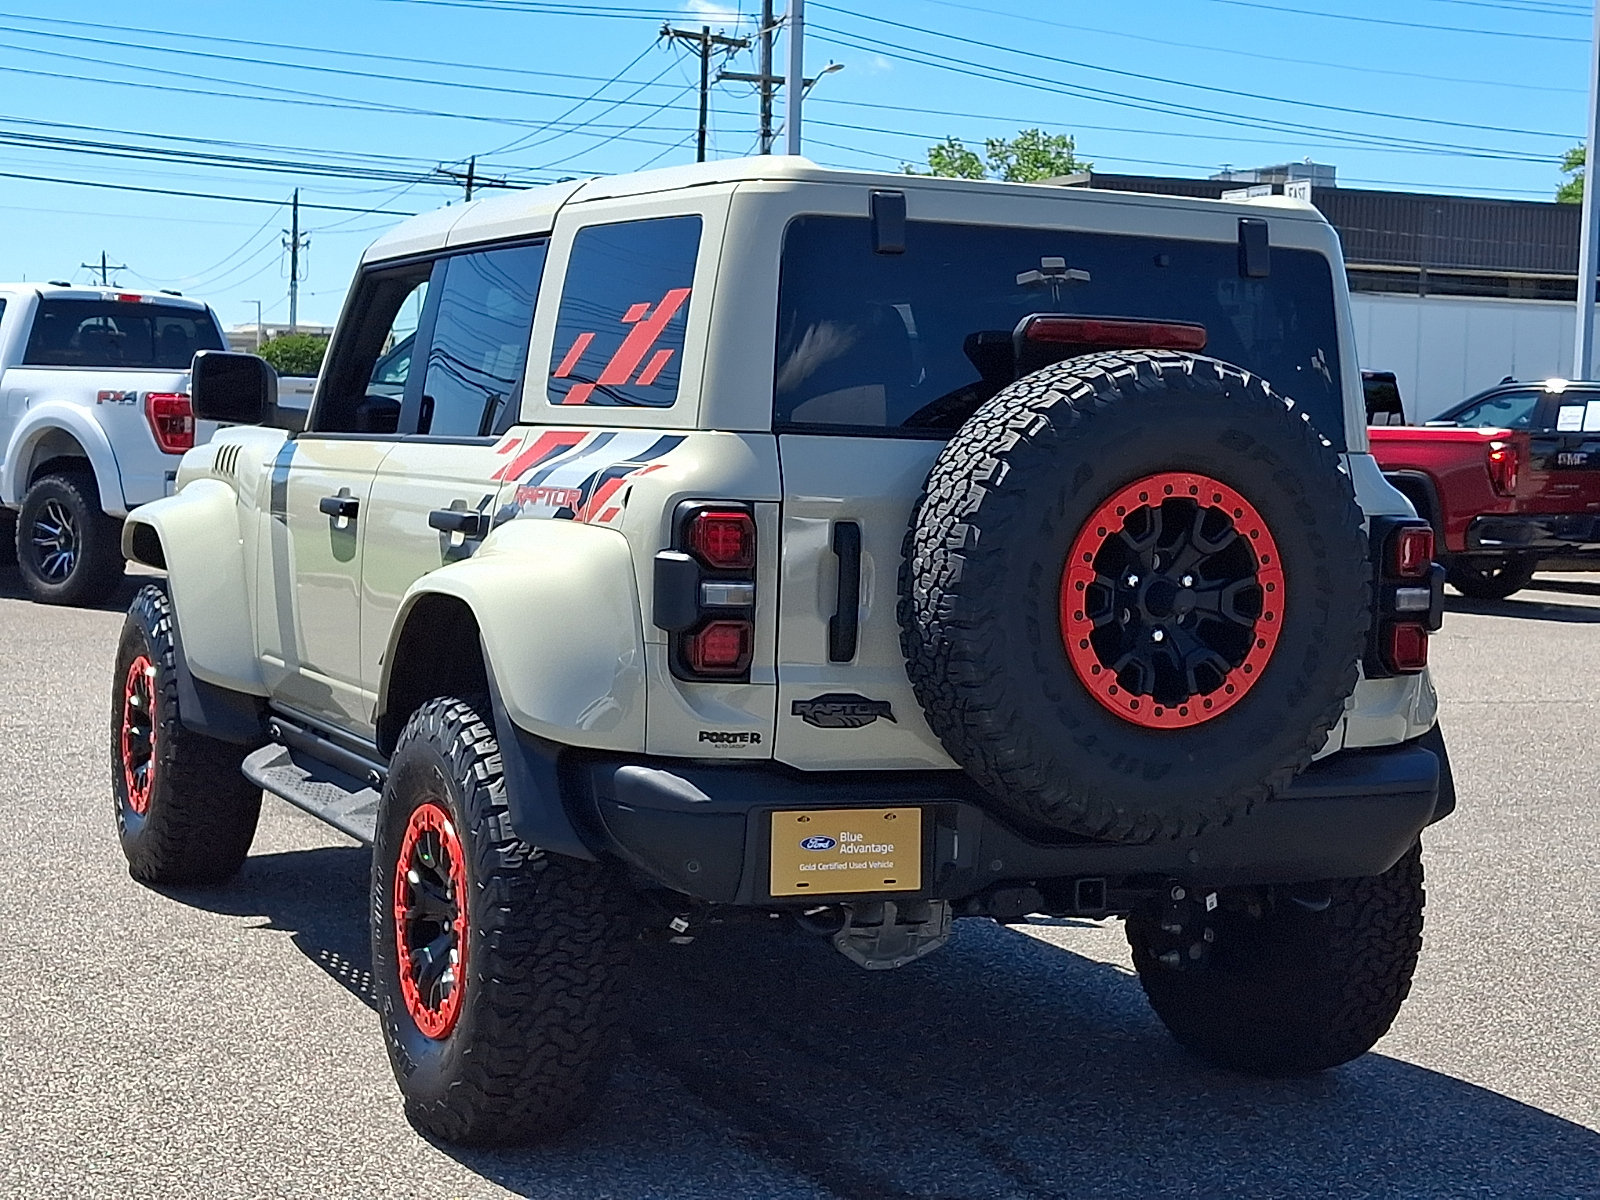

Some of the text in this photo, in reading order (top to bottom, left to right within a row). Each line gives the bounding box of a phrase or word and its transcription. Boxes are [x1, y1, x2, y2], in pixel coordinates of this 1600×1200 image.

[97, 390, 138, 404] FX4
[1558, 452, 1588, 465] GMC
[515, 485, 582, 515] RAPTOR
[793, 701, 896, 723] RAPTOR
[699, 731, 761, 744] PORTER
[840, 832, 863, 842] Blue
[840, 843, 894, 854] Advantage
[799, 860, 894, 871] Gold Certified Used Vehicle
